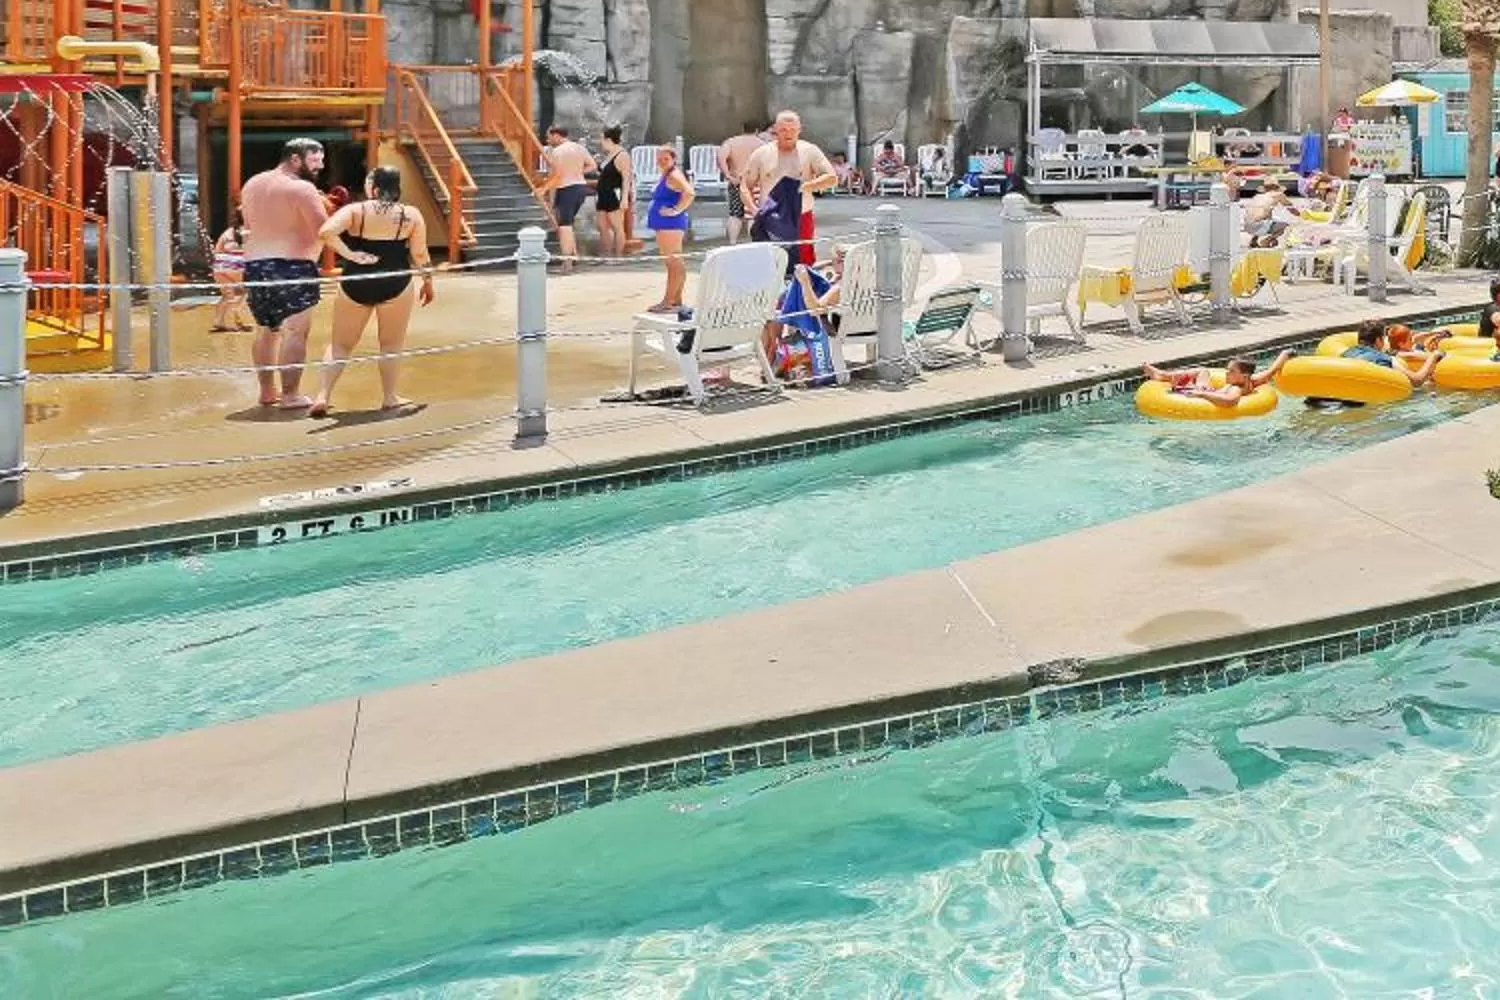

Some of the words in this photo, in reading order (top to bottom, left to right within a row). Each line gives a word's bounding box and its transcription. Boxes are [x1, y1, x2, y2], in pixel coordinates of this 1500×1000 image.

[272, 527, 289, 544] 2
[301, 519, 335, 537] FT
[380, 509, 409, 526] IN
